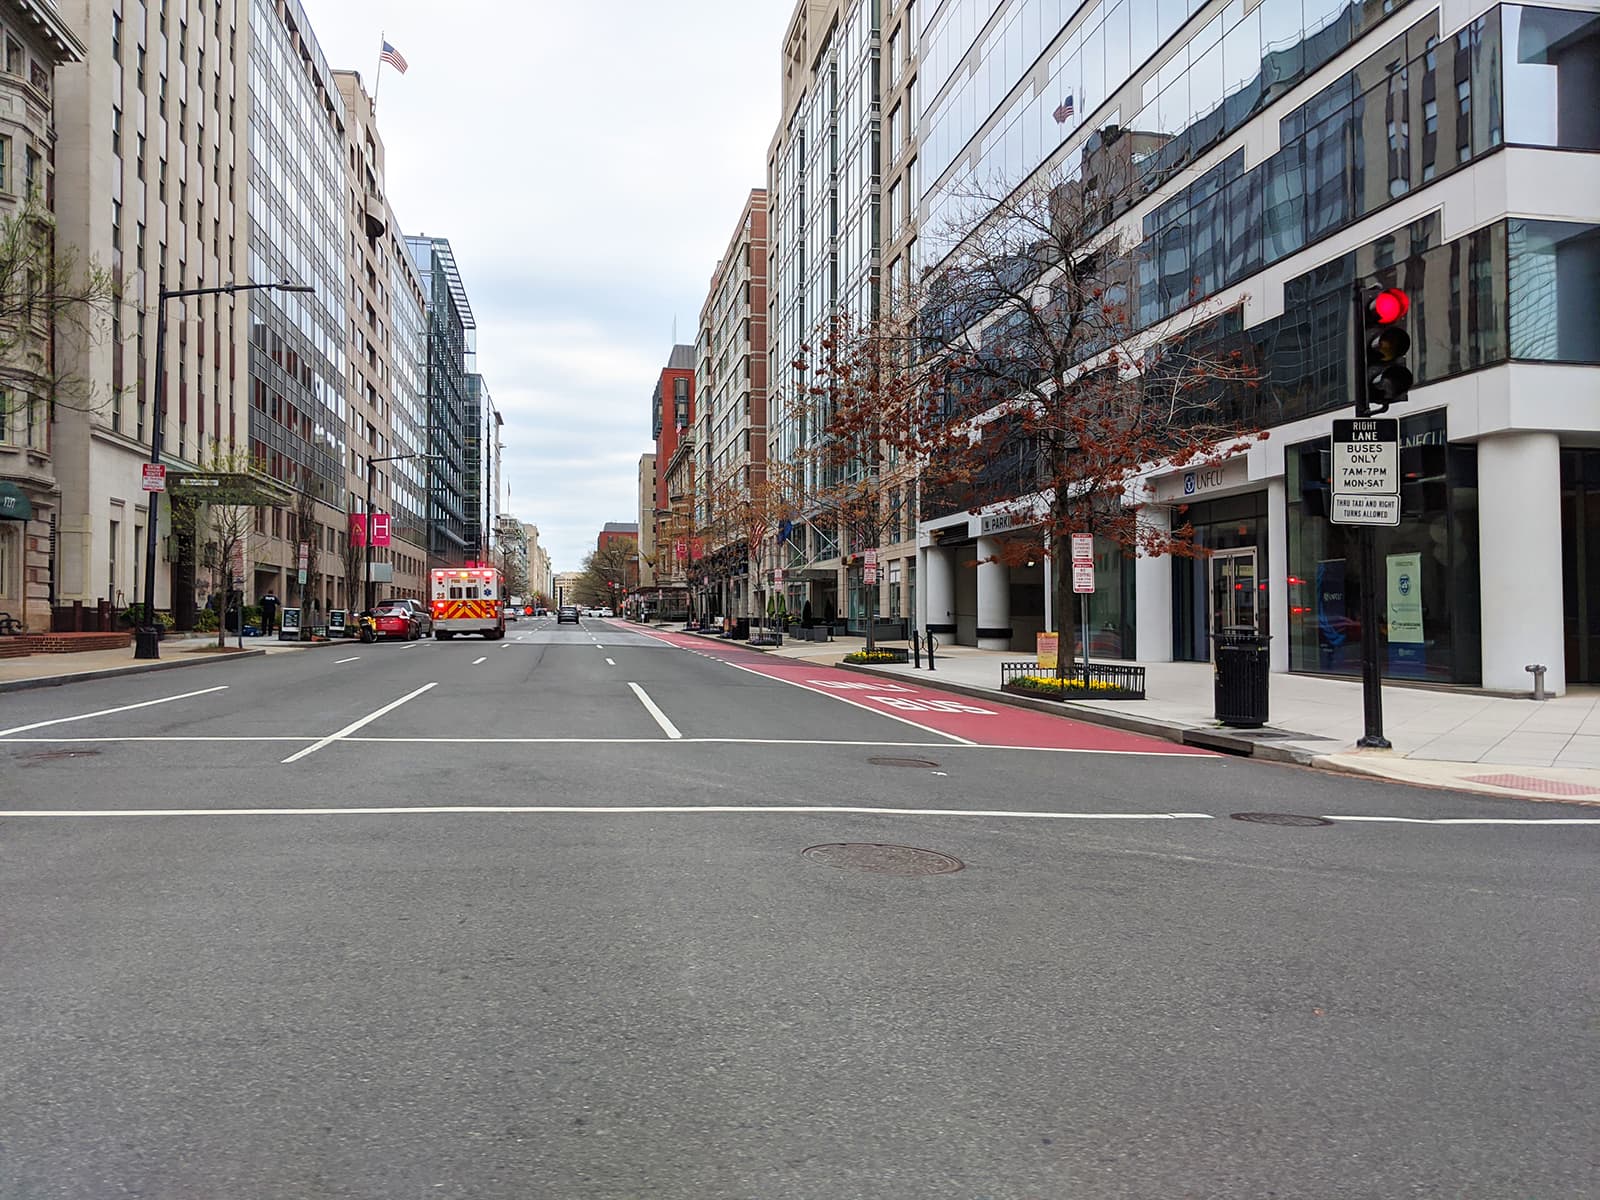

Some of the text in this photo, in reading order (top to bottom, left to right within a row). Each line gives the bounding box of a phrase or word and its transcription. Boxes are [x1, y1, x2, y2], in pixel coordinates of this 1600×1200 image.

[1352, 421, 1377, 431] RIGHT
[1352, 431, 1378, 441] LANE
[1346, 444, 1383, 453] BUSES
[1350, 454, 1378, 464] ONLY
[1342, 467, 1387, 476] 7AM-7PM
[1196, 470, 1223, 490] UNFCU
[1344, 479, 1385, 488] MON-SAT
[1336, 499, 1351, 507] THRU
[1366, 500, 1377, 508] AND
[1379, 501, 1395, 509] RIGHT
[1344, 509, 1388, 519] TURNS ALLOWED
[865, 695, 999, 715] BUS
